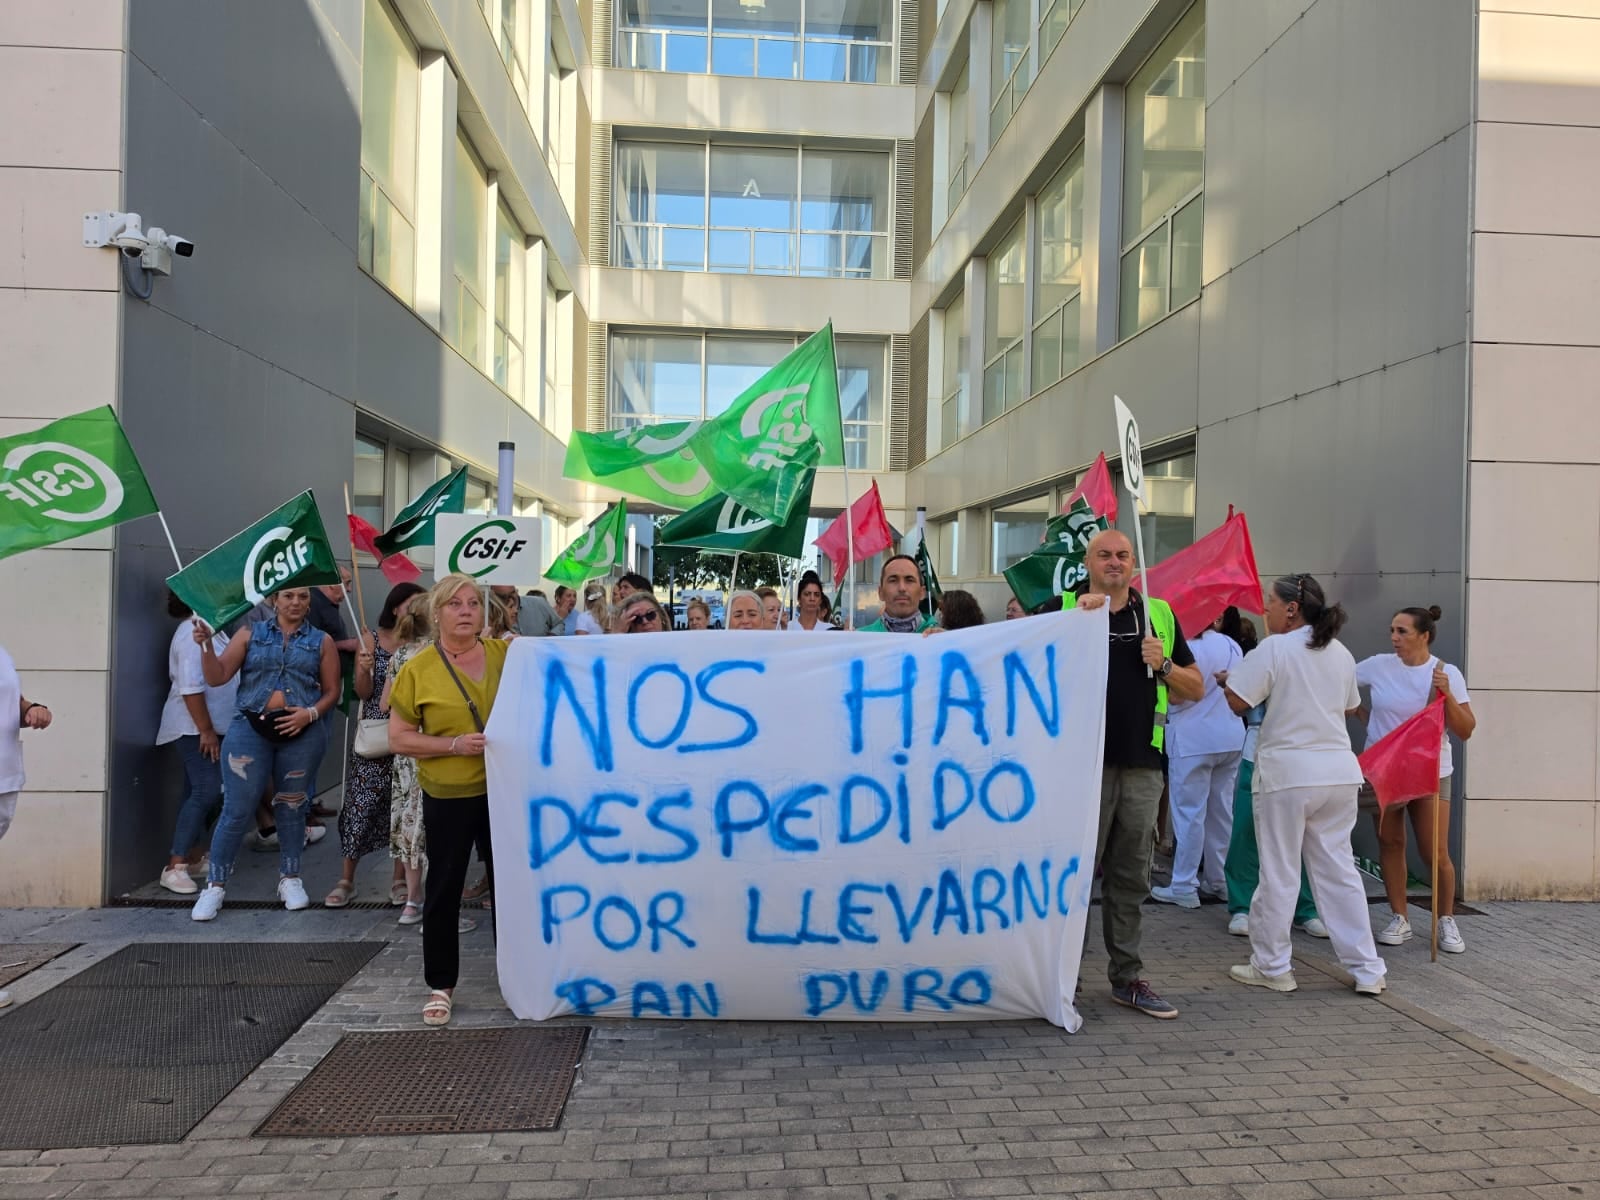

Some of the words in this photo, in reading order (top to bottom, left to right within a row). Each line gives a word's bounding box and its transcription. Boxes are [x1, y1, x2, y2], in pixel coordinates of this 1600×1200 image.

[258, 535, 308, 592] CSIF
[1064, 562, 1089, 590] CS
[539, 655, 767, 773] NOS
[842, 642, 1062, 755] HAN
[538, 882, 698, 954] POR
[553, 975, 721, 1018] PAN
[804, 967, 993, 1017] DURO
